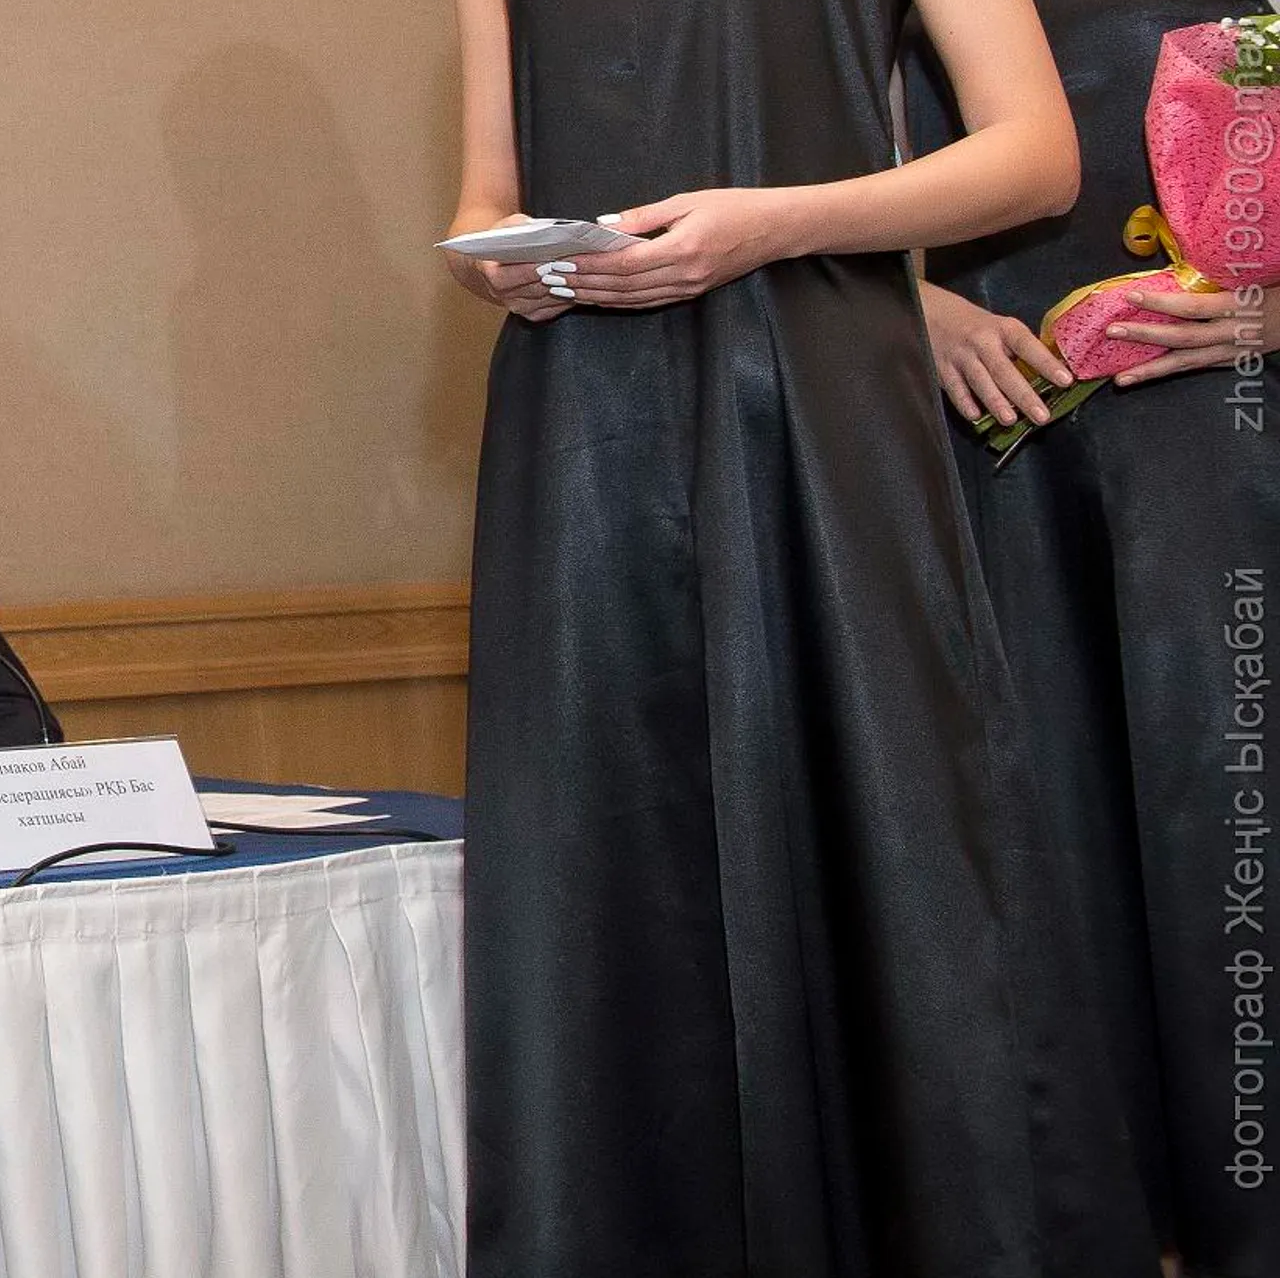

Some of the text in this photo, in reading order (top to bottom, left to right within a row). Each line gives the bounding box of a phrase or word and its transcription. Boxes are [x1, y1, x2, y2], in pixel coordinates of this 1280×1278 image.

[50, 755, 86, 771] Абай
[96, 780, 126, 797] РҚБ
[130, 778, 155, 794] Бас
[18, 811, 85, 827] хатшысы
